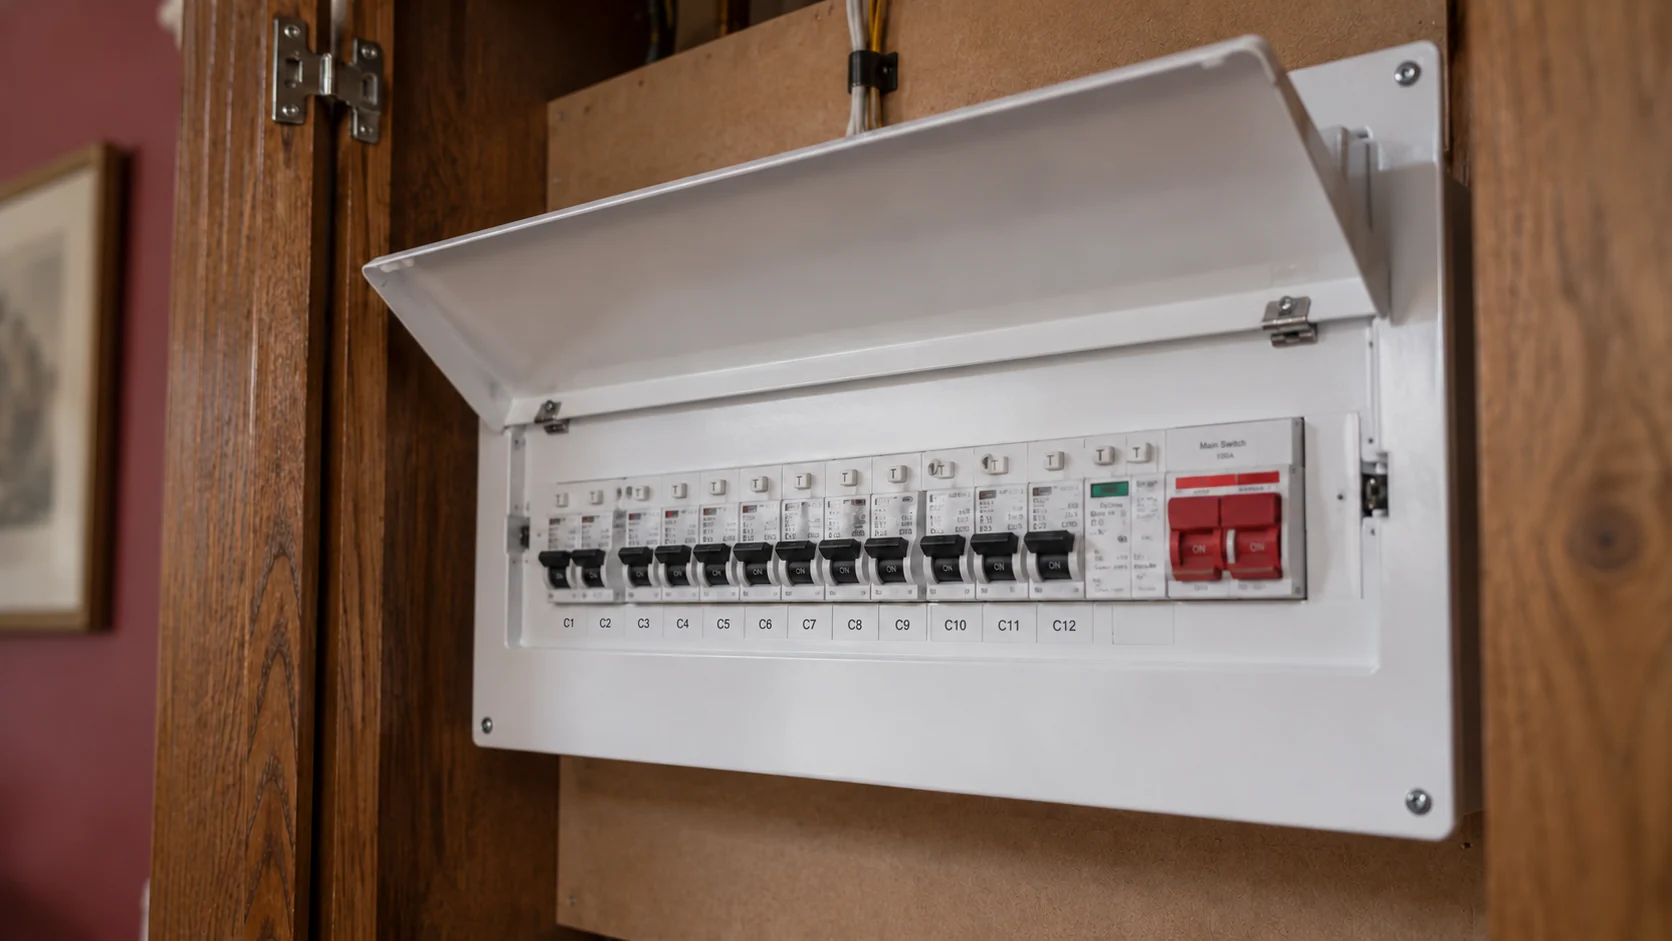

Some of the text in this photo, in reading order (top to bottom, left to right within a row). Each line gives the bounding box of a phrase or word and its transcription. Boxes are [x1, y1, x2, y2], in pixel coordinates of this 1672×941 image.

[1199, 439, 1247, 450] Main Switch
[1192, 545, 1206, 554] ON
[1250, 542, 1265, 552] ON
[839, 566, 850, 574] ON
[885, 565, 897, 573] ON
[942, 564, 953, 572] ON
[993, 562, 1005, 571] ON
[1048, 561, 1061, 570] ON
[795, 567, 806, 575] ON
[563, 618, 575, 628] C1
[600, 618, 612, 628] C2
[638, 618, 650, 628] C3
[676, 618, 689, 629] C4
[716, 618, 731, 629] C5
[758, 618, 773, 630] C6
[802, 619, 817, 630] C7
[847, 619, 863, 630] C8
[895, 619, 910, 630] C9
[944, 619, 967, 631] C10
[998, 619, 1020, 631] C11
[1052, 619, 1076, 632] C12
